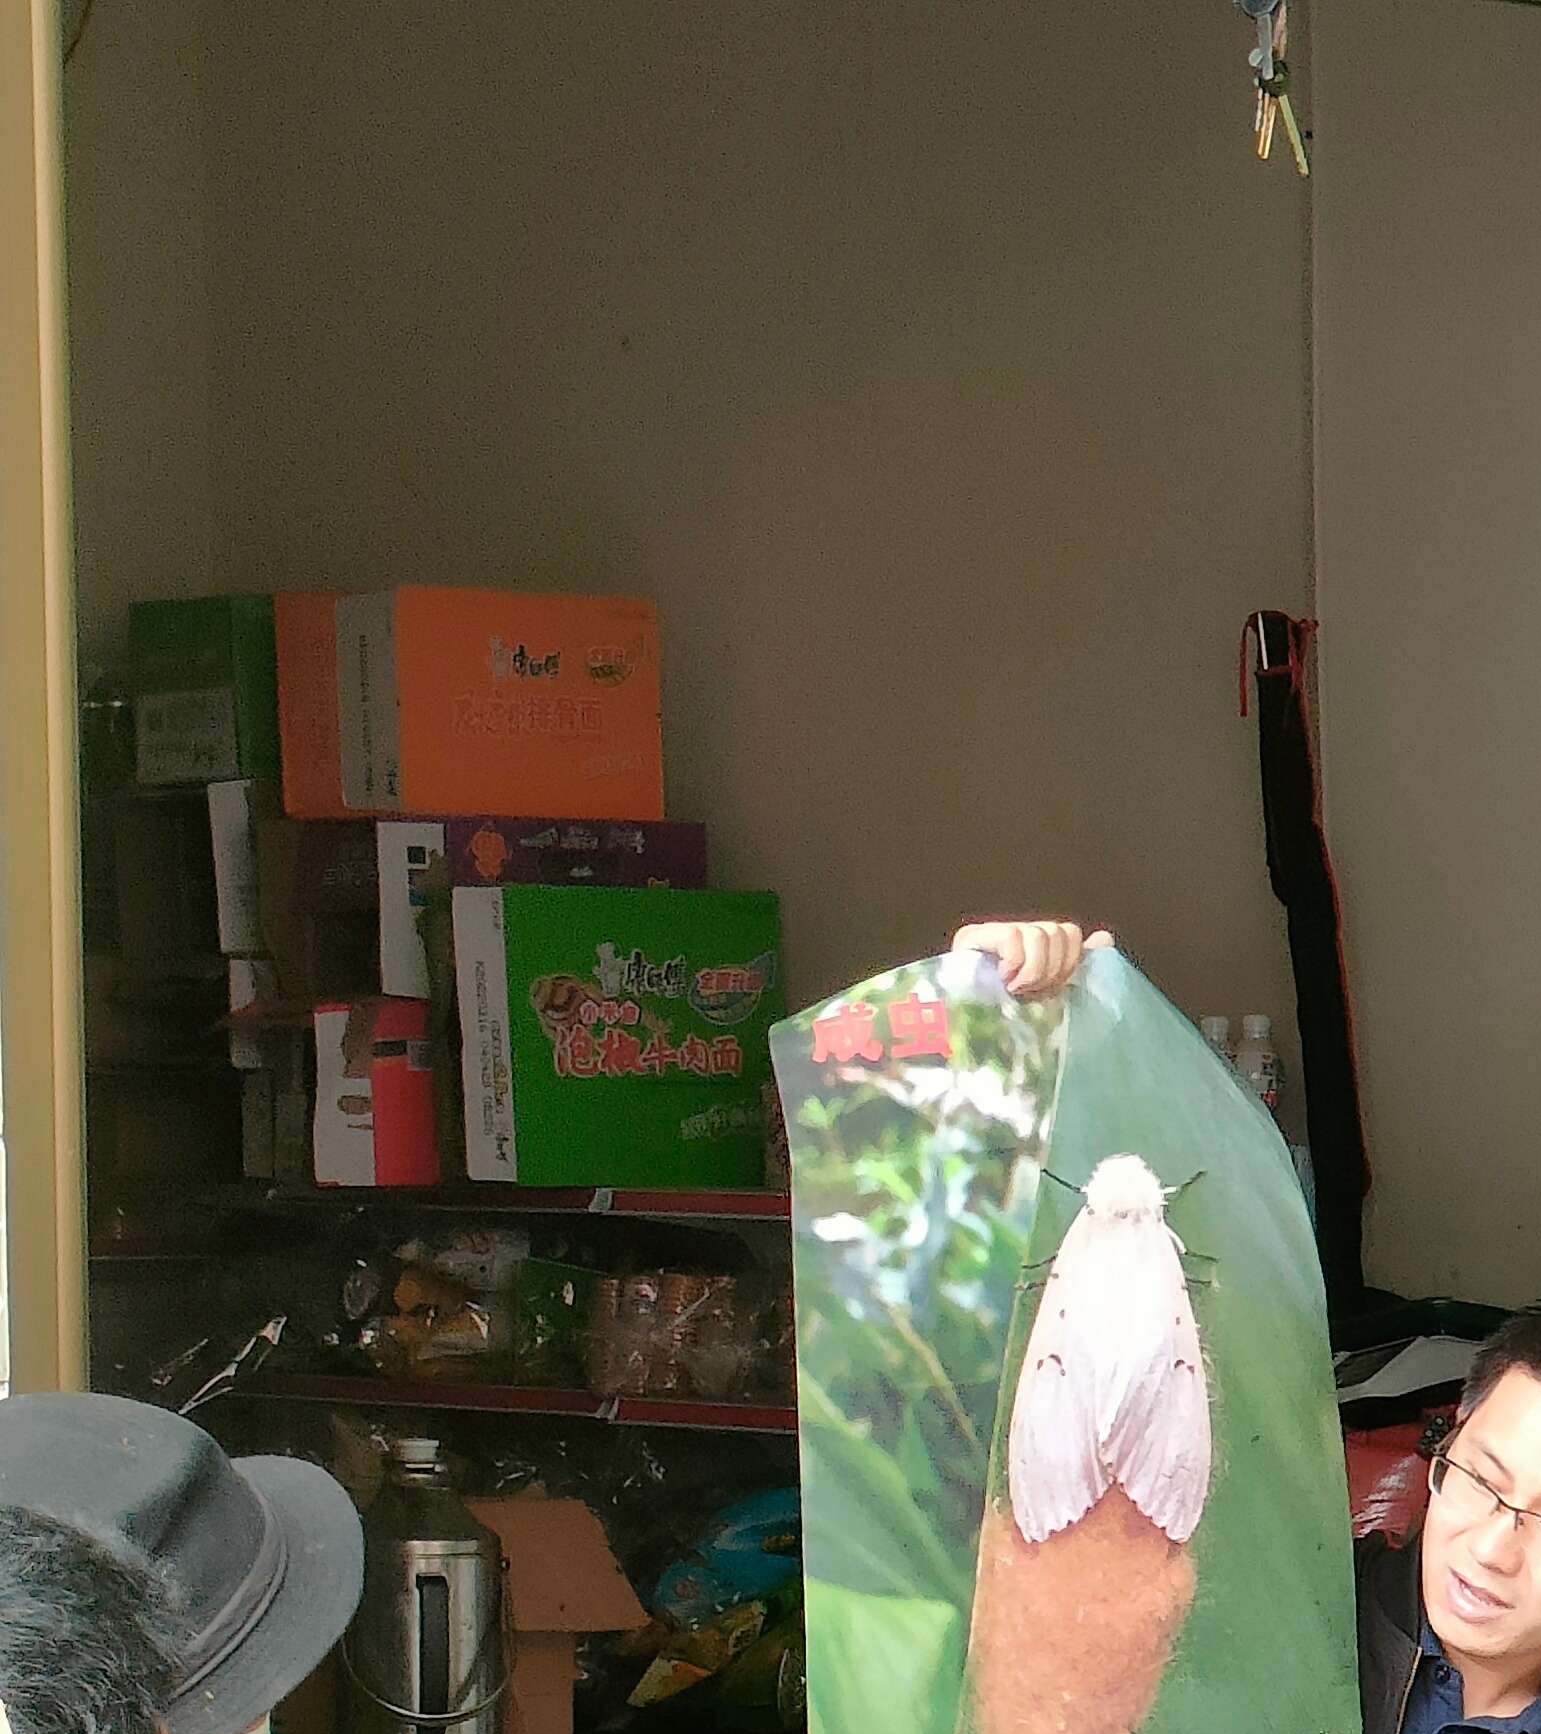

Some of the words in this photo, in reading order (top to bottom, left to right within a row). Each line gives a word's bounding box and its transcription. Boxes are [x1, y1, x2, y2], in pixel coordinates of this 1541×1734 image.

[556, 1024, 743, 1078] 泡椒牛肉面
[811, 992, 951, 1066] 成虫
